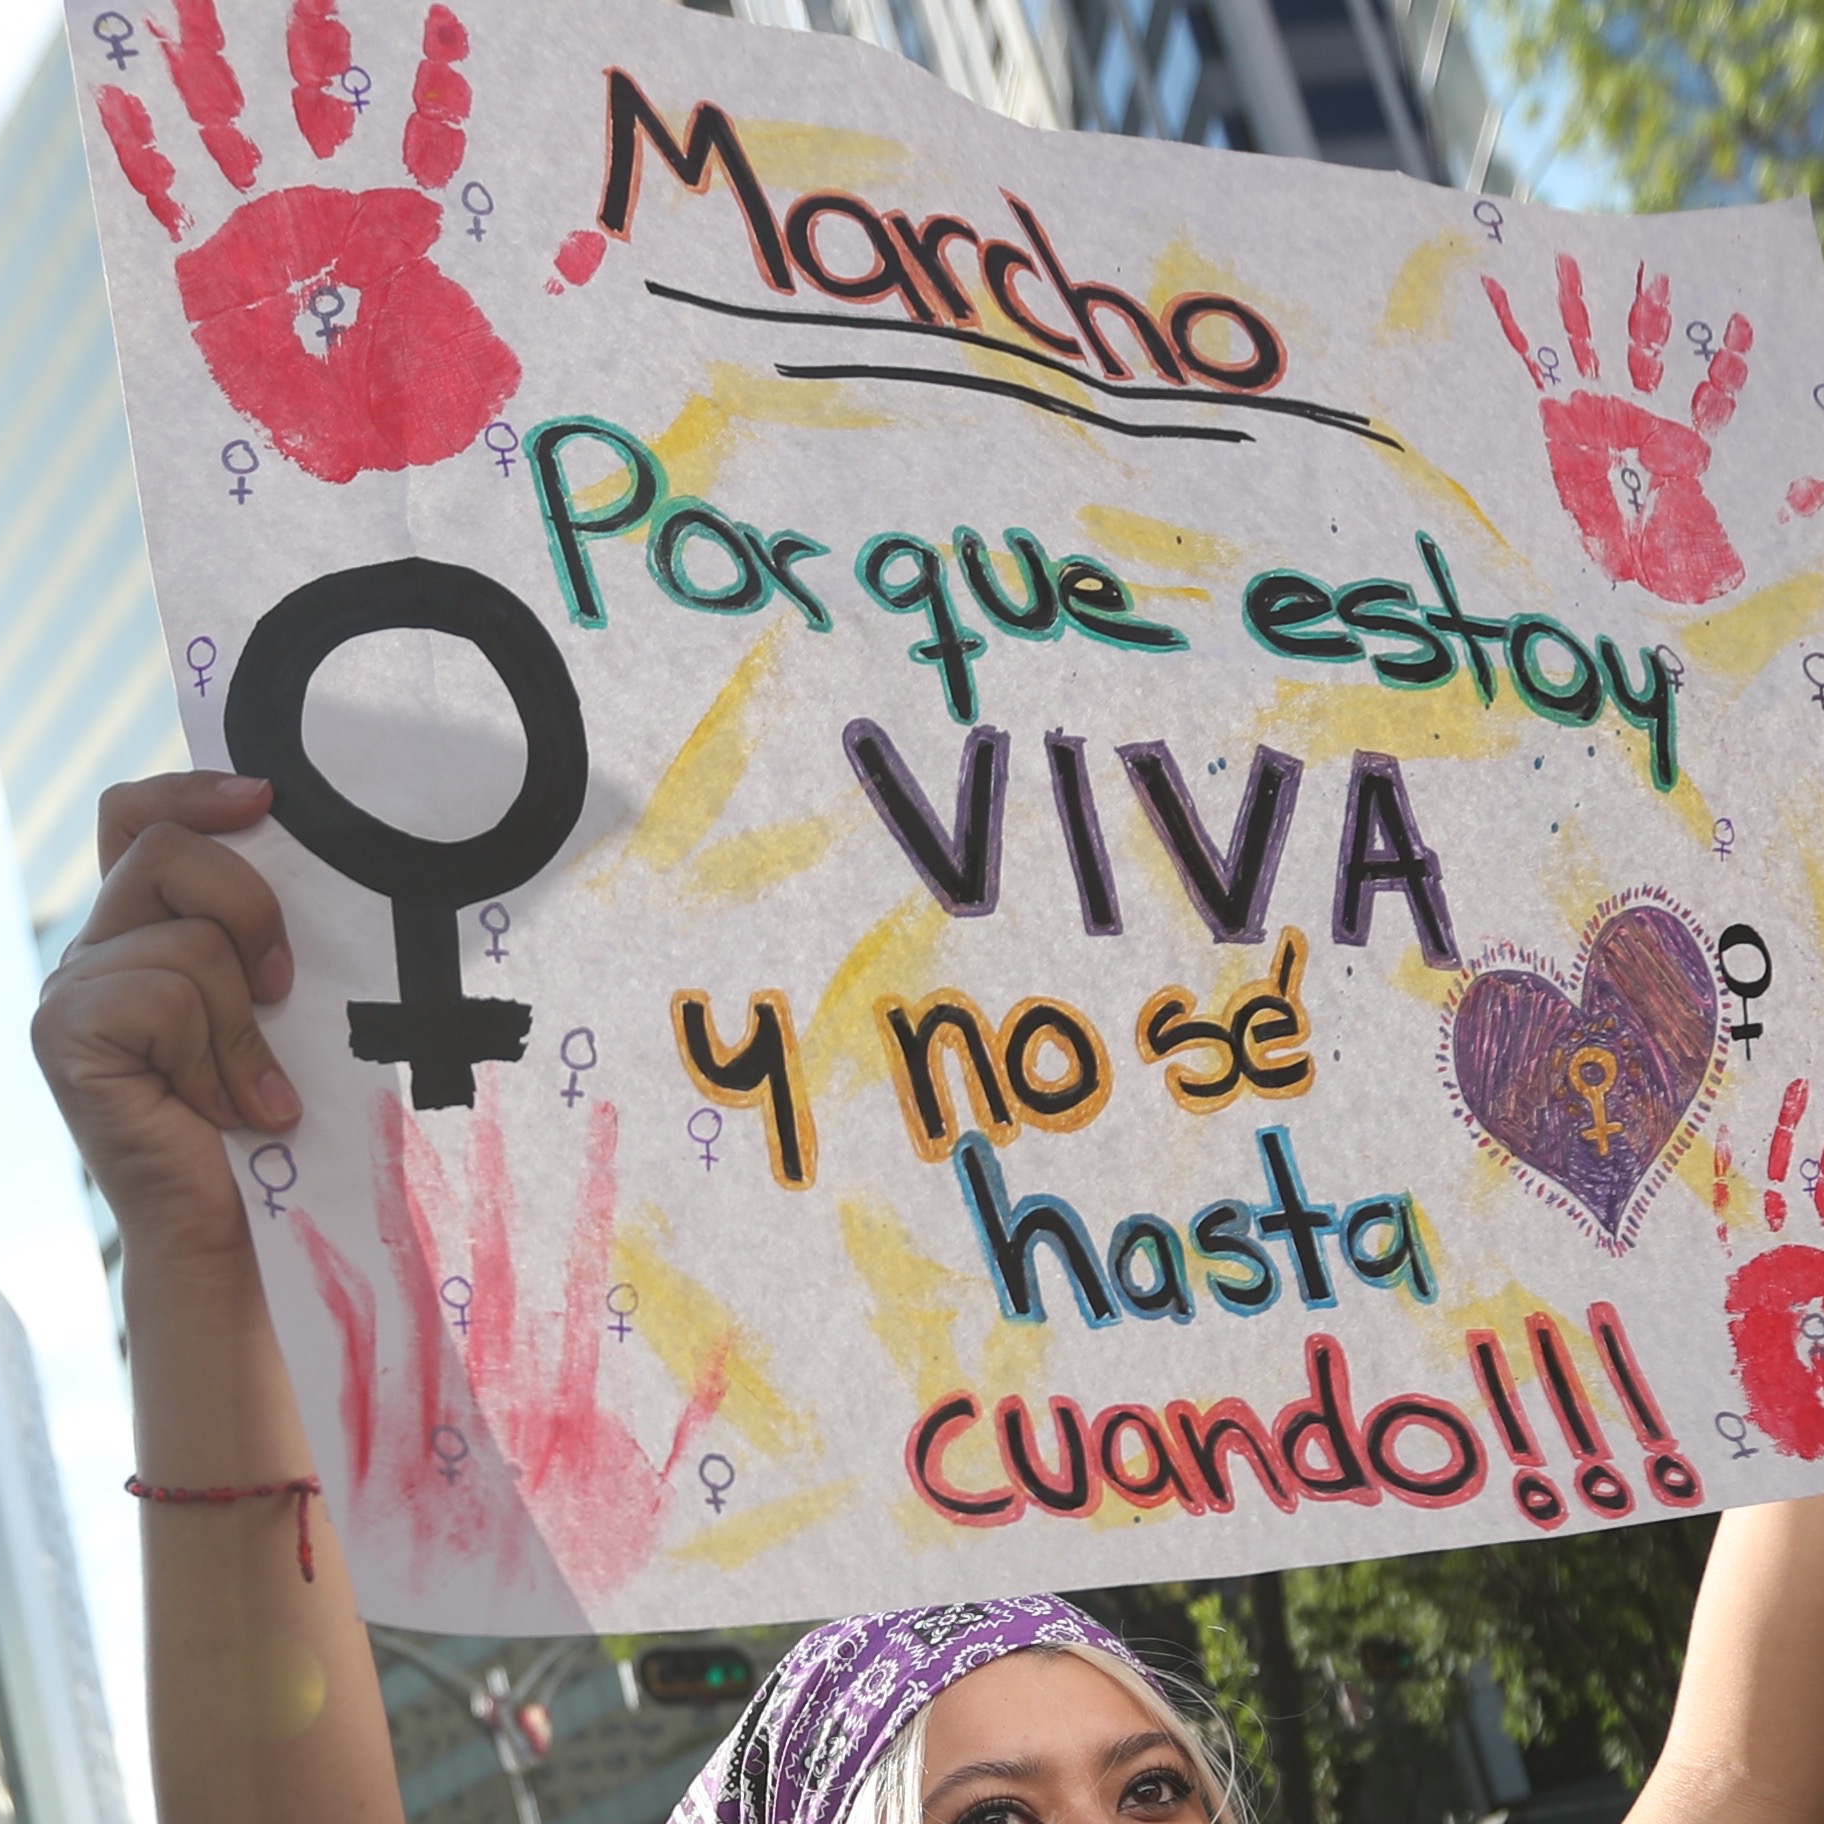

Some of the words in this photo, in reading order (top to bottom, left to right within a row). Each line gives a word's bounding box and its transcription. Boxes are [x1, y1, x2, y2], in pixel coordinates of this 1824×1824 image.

[596, 66, 1288, 394] Marcho
[1242, 530, 1676, 792] estoy
[842, 718, 1462, 970] VIVA
[876, 988, 1113, 1164] no
[1138, 926, 1316, 1114] sé
[952, 1124, 1440, 1328] hasta
[904, 1300, 1706, 1530] cuando!!!
